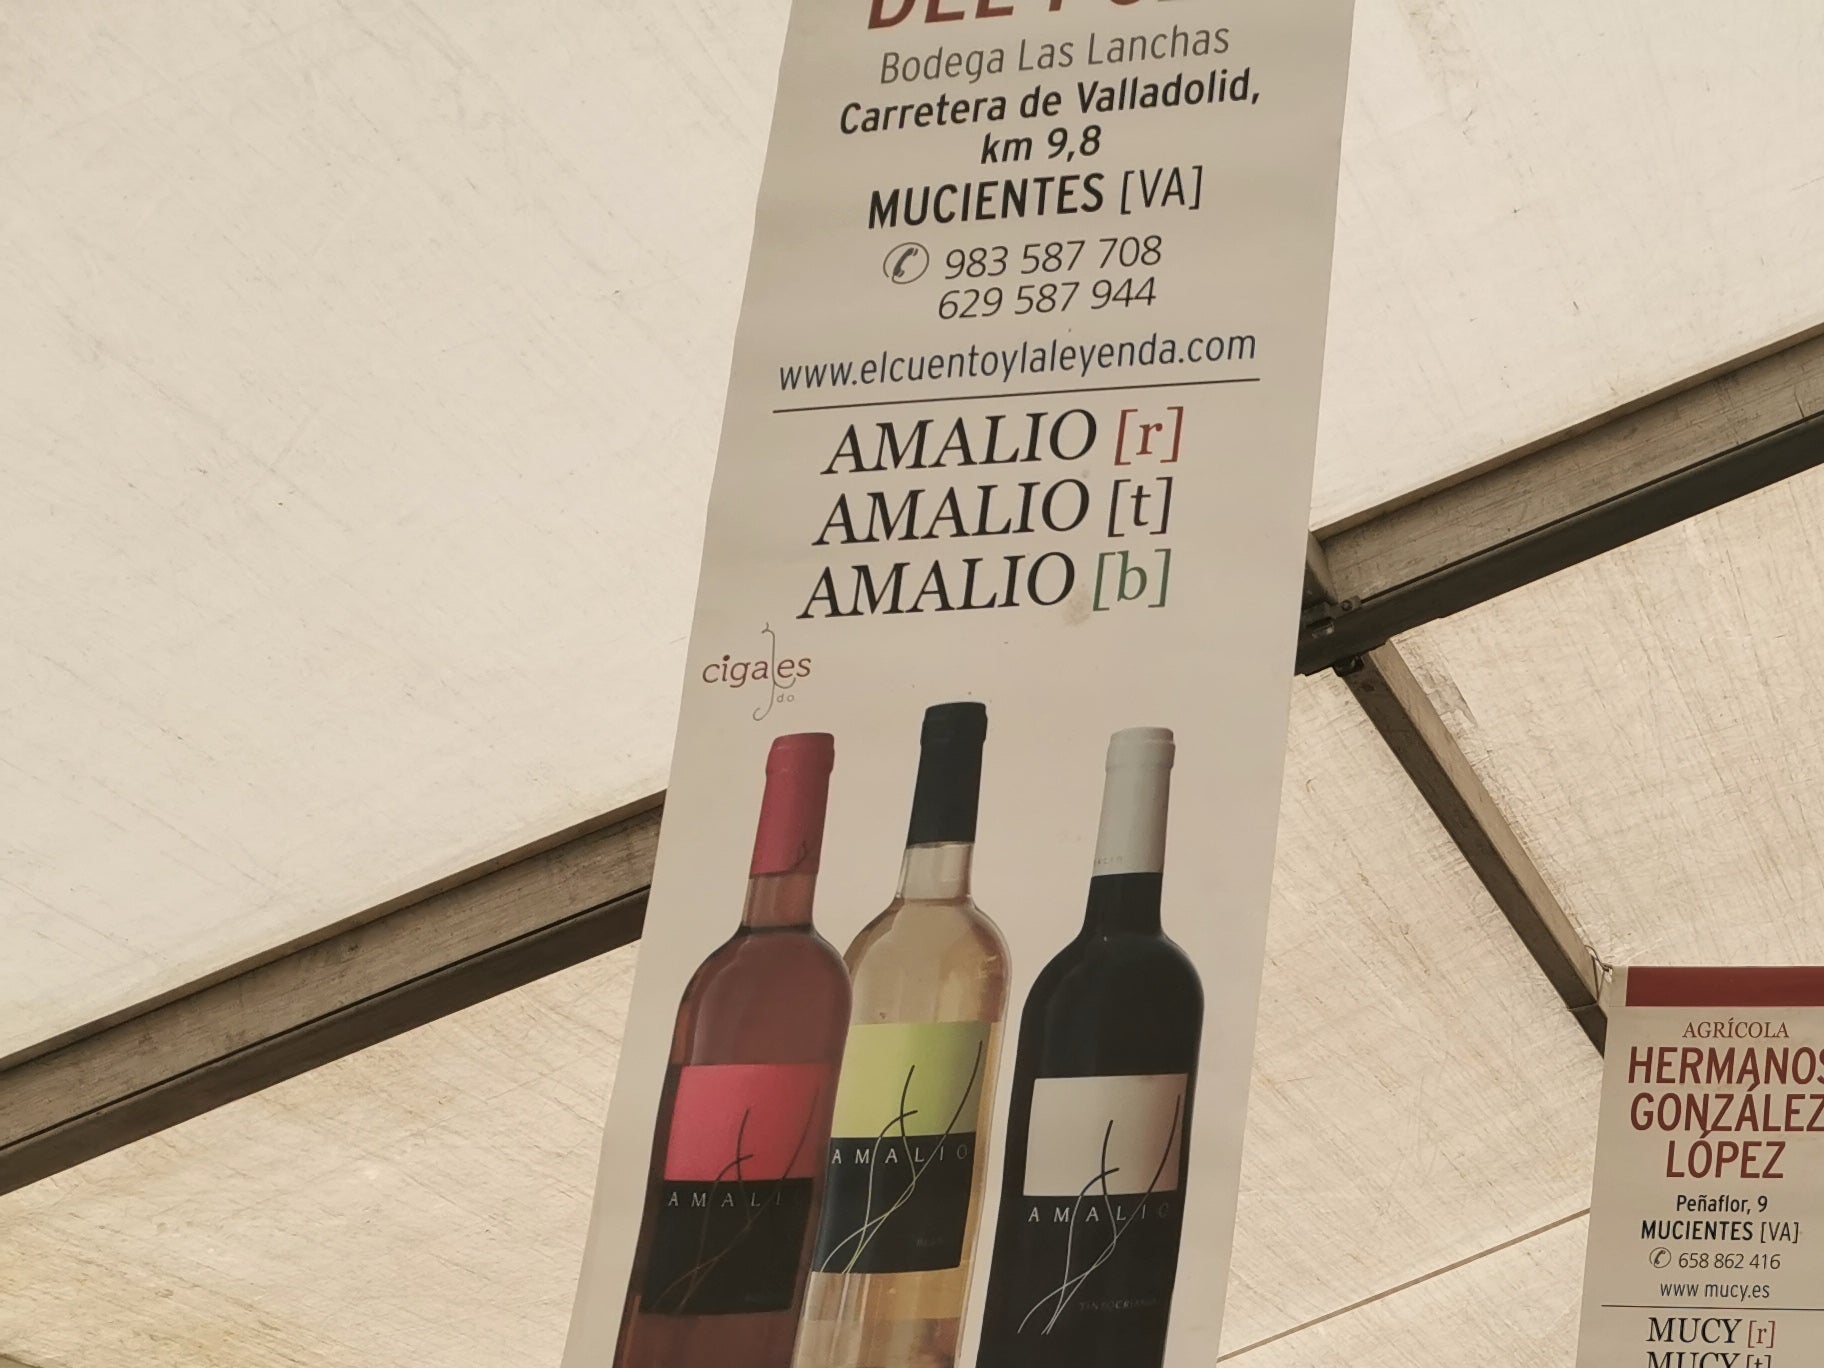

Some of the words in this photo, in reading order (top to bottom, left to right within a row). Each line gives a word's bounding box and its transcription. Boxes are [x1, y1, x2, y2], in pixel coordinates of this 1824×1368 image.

[880, 46, 1004, 84] Bodega
[1018, 39, 1074, 72] Las
[1087, 26, 1230, 66] Lanchas
[840, 93, 1006, 135] Carretera
[1019, 86, 1062, 119] de
[1078, 68, 1261, 114] Valladolid,
[981, 132, 1033, 165] km
[1047, 125, 1102, 162] 9,8
[868, 173, 1105, 230] MUCIENTES
[1120, 165, 1204, 215] [VA]
[945, 246, 1009, 280] 983
[1020, 240, 1085, 275] 587
[1099, 235, 1163, 269] 708
[938, 286, 1003, 320] 629
[1014, 281, 1080, 316] 587
[1091, 277, 1156, 312] 944
[779, 333, 1257, 391] www.elcuentoylaleyenda.com
[820, 408, 1097, 475] AMALIO
[1114, 406, 1185, 466] [r]
[812, 478, 1090, 546] AMALIO
[1107, 476, 1174, 537] [t]
[796, 551, 1076, 620] AMALIO
[1093, 548, 1172, 612] [b]
[1681, 1017, 1790, 1039] AGRÍCOLA
[1666, 1130, 1786, 1179] LÓPEZ
[1676, 1194, 1751, 1214] Peñaflor,
[1757, 1195, 1768, 1213] 9
[1641, 1220, 1753, 1241] MUCIENTES
[1760, 1221, 1799, 1244] [VA]
[1678, 1253, 1709, 1269] 658
[1714, 1253, 1744, 1269] 862
[1749, 1254, 1781, 1270] 416
[1646, 1317, 1743, 1344] MUCY
[1747, 1320, 1776, 1348] [r]
